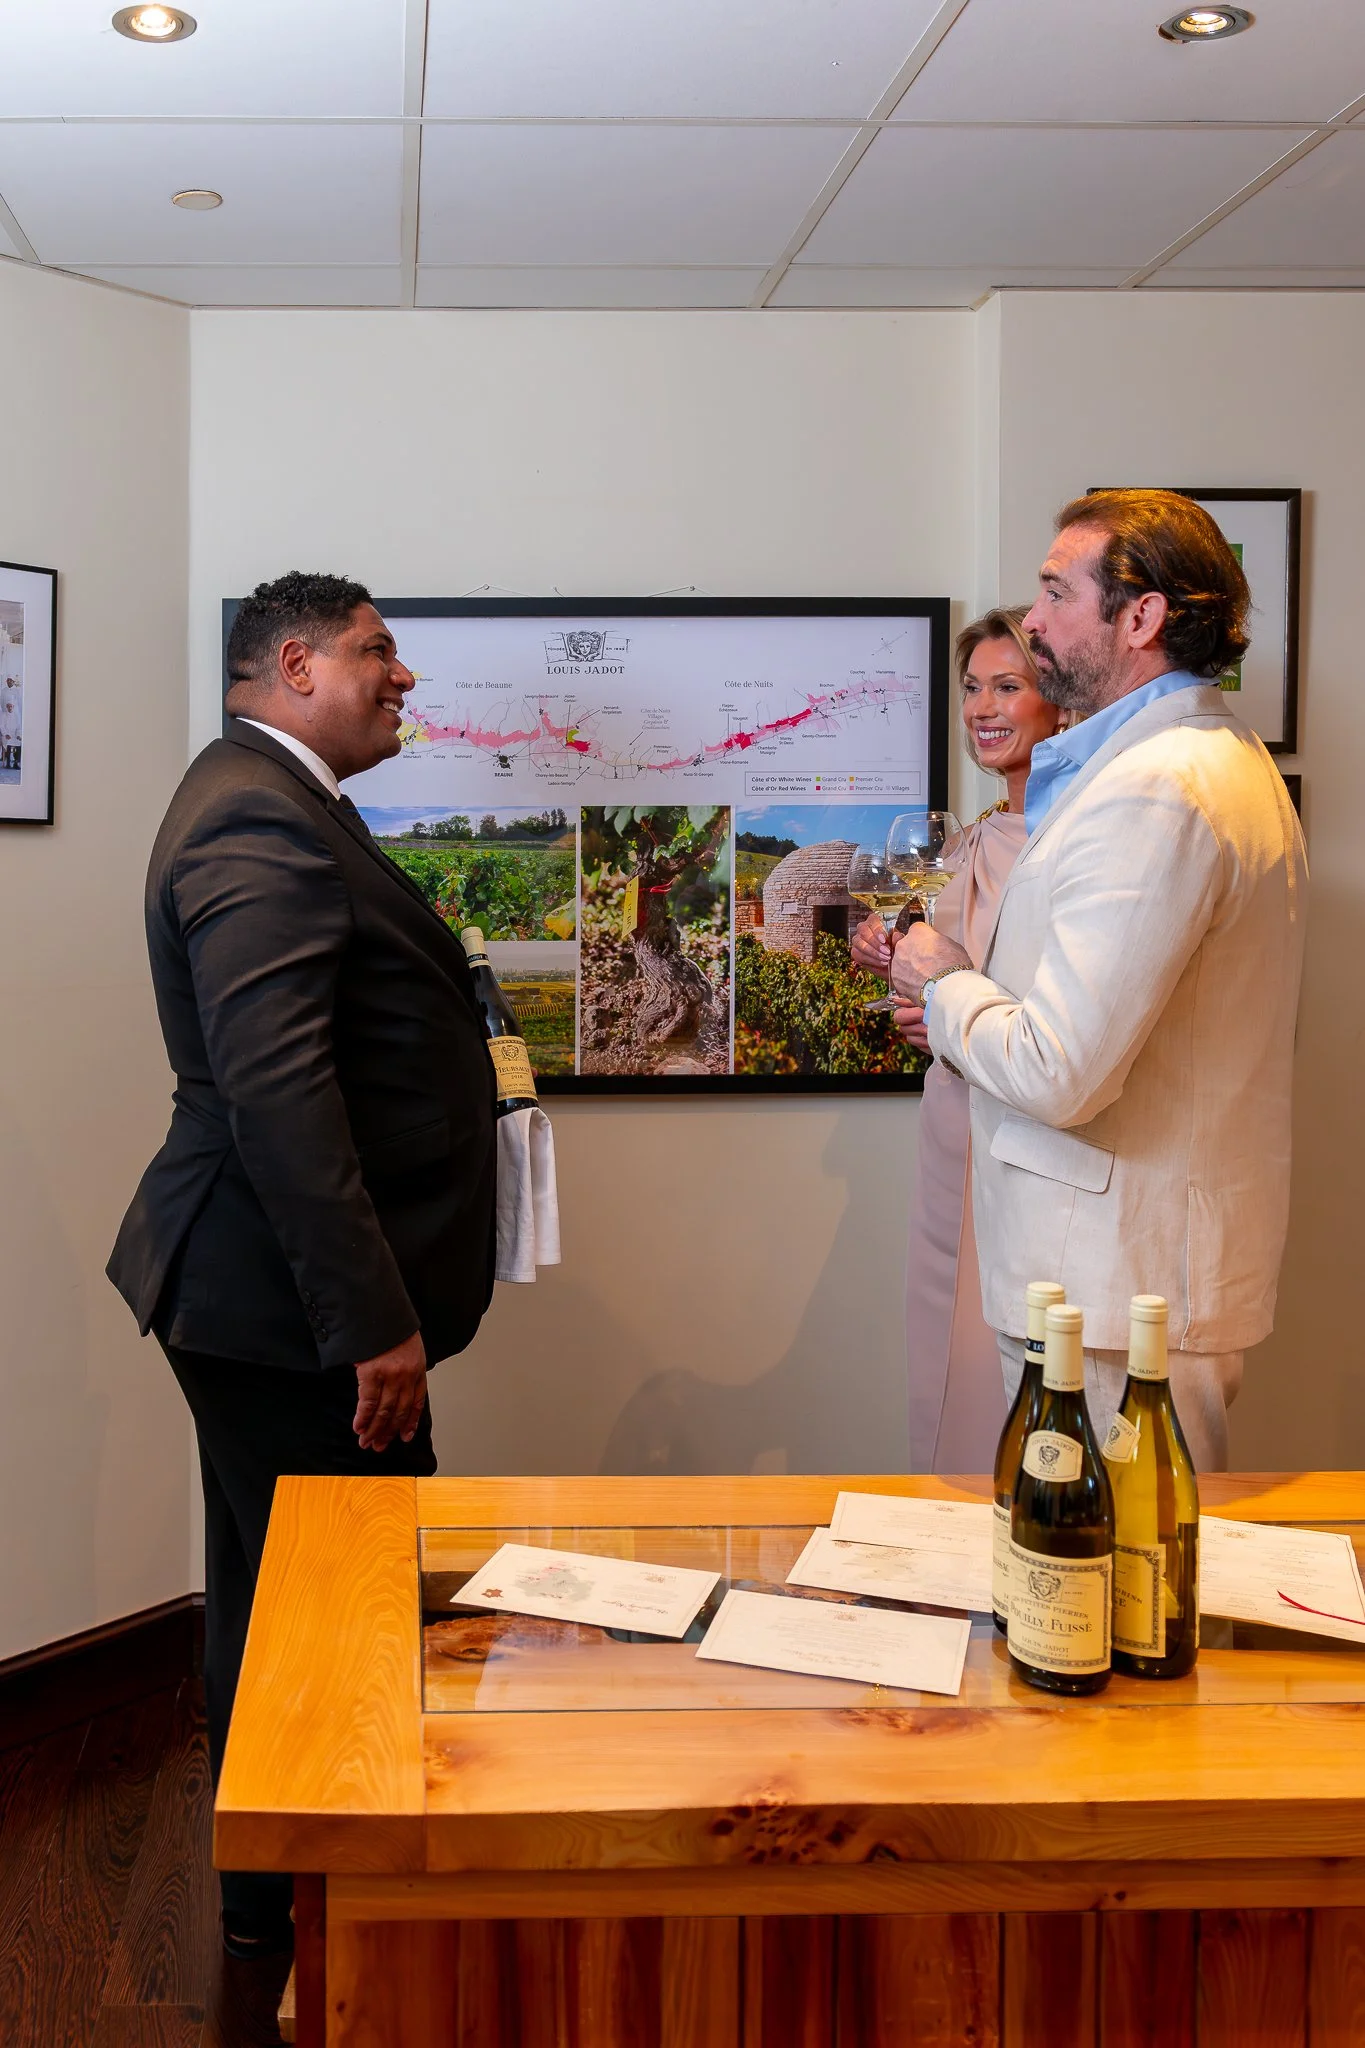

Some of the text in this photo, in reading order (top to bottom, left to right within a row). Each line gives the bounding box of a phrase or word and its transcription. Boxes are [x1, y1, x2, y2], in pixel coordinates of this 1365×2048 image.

[547, 666, 625, 675] LOUIS JADOT
[455, 681, 513, 689] Côte de Beaune
[724, 680, 774, 688] Côte de Nuits
[1053, 1605, 1089, 1620] PIERRES
[1043, 1642, 1070, 1654] JADOT
